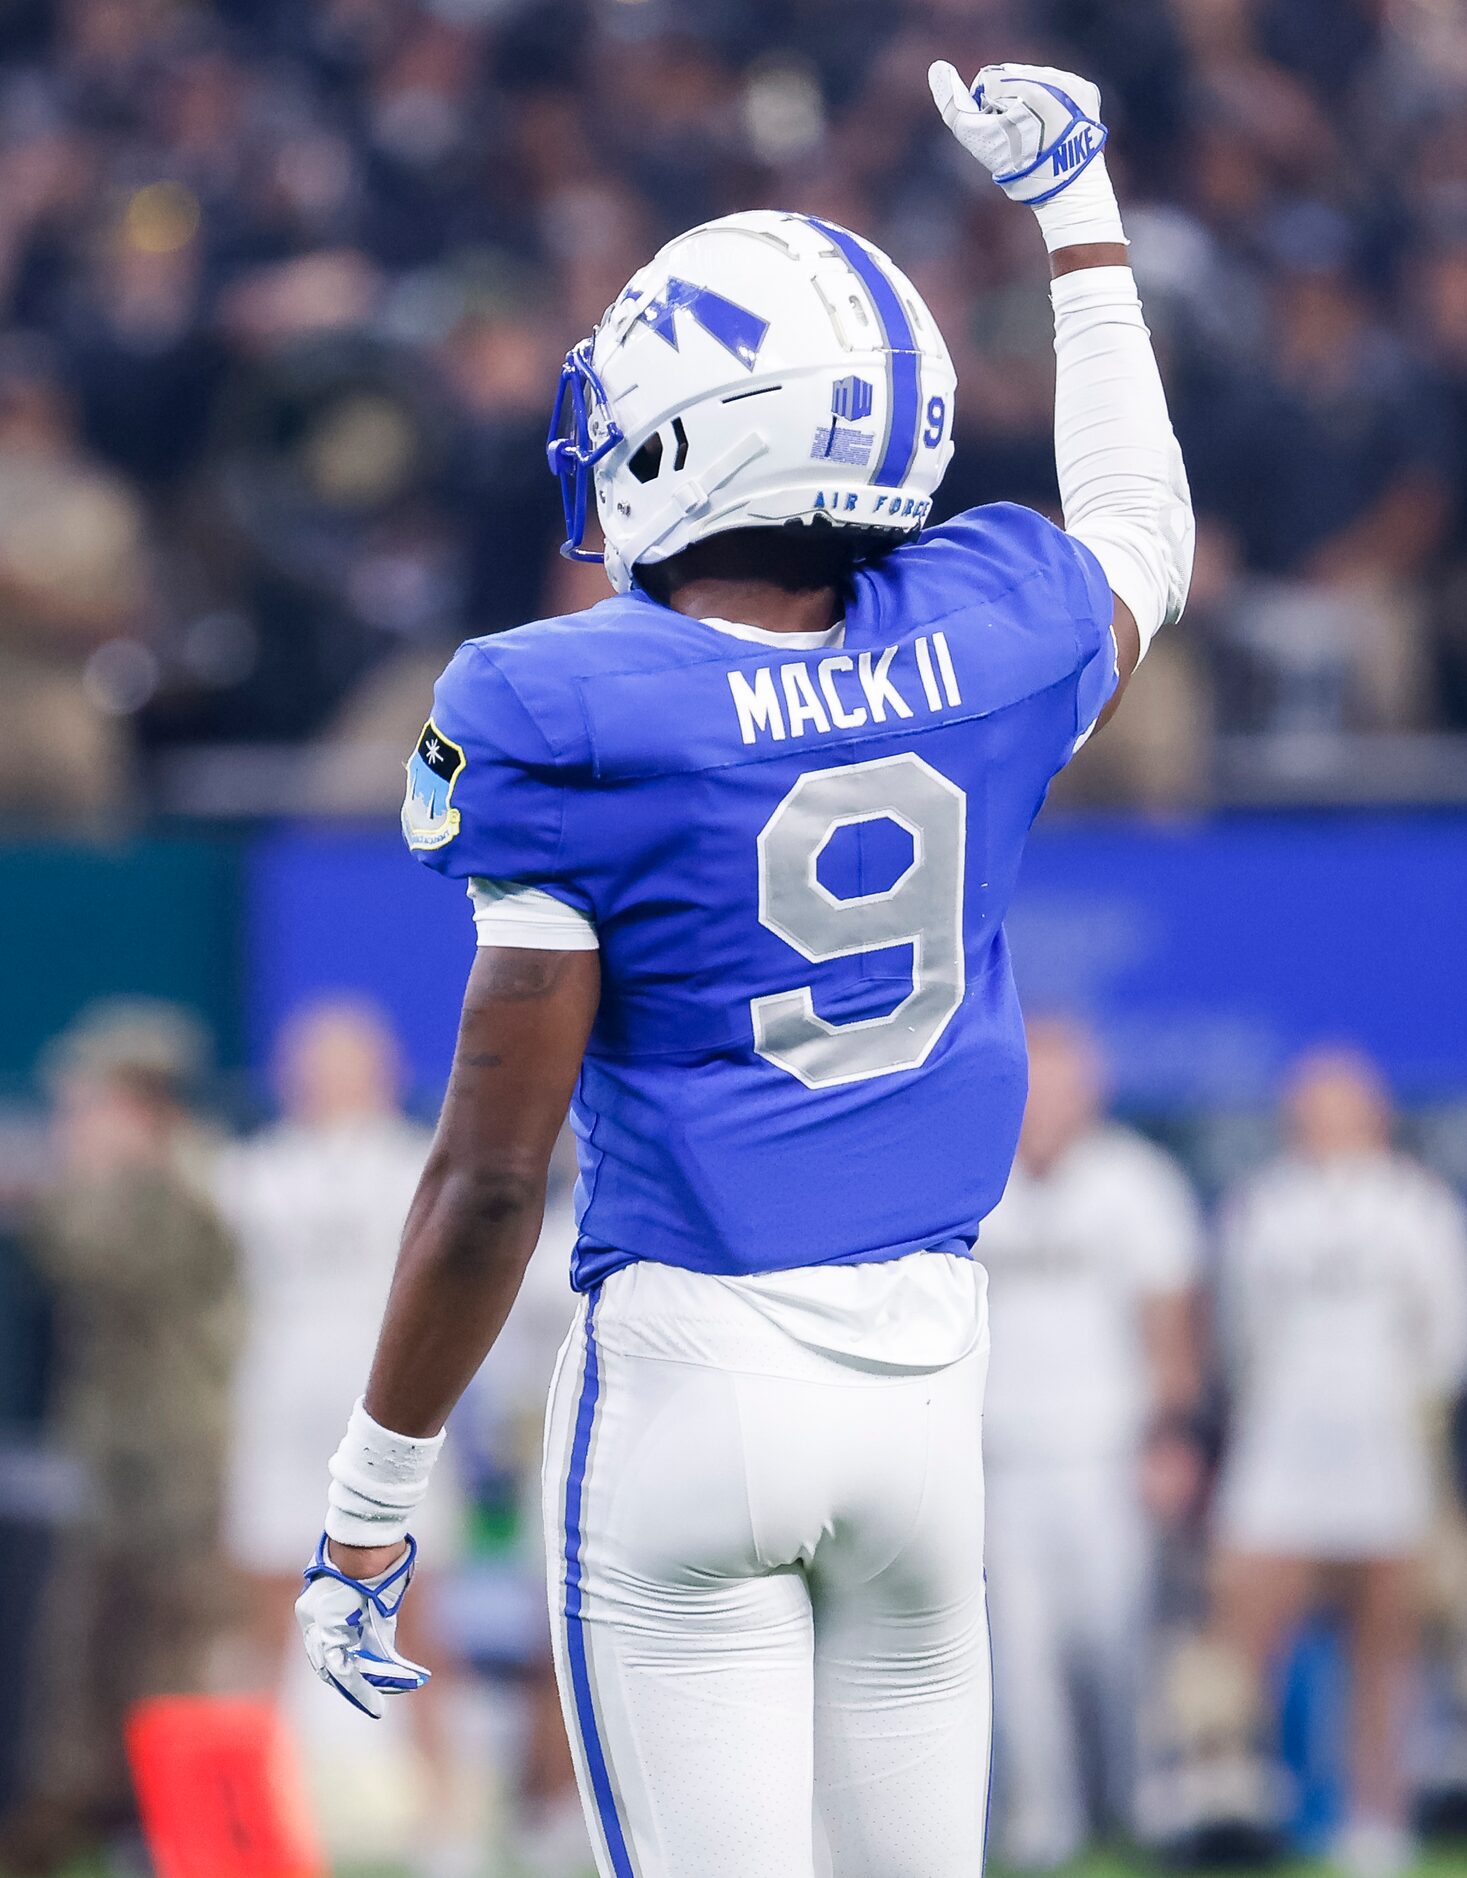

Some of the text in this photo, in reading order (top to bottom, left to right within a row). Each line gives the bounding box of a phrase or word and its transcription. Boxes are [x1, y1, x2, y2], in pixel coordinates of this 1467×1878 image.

[1052, 126, 1095, 177] NIKE
[923, 396, 945, 449] 9
[814, 491, 930, 518] AIR FORCE
[727, 631, 962, 744] MACK II
[750, 751, 967, 1090] 9
